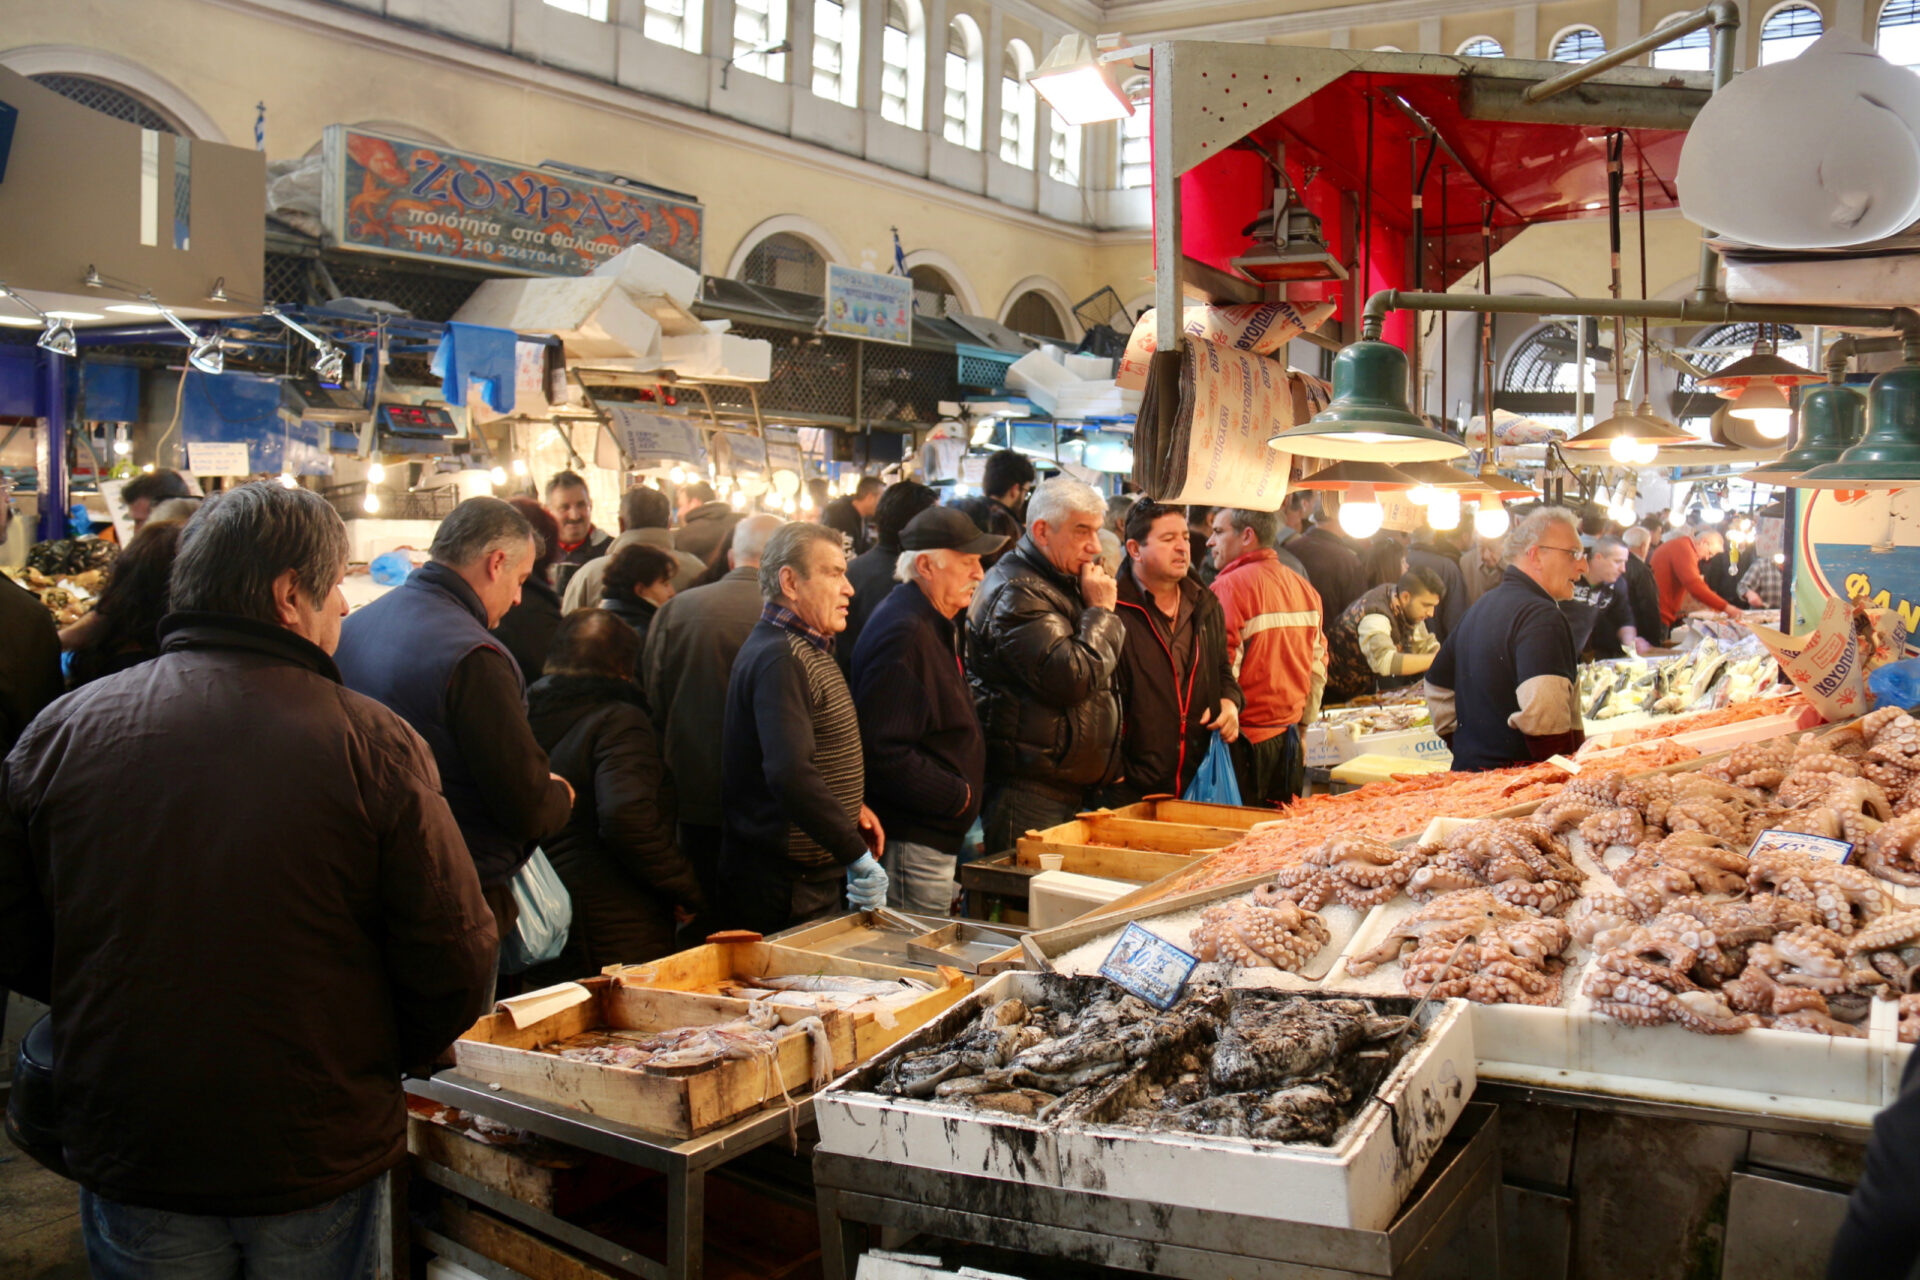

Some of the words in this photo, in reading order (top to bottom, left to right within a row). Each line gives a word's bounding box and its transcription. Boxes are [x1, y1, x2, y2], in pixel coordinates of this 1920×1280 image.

[410, 157, 647, 240] ΖΟΥΡΑΣ
[462, 237, 495, 254] 210
[511, 226, 547, 244] στα
[551, 230, 626, 256] θαλασσ
